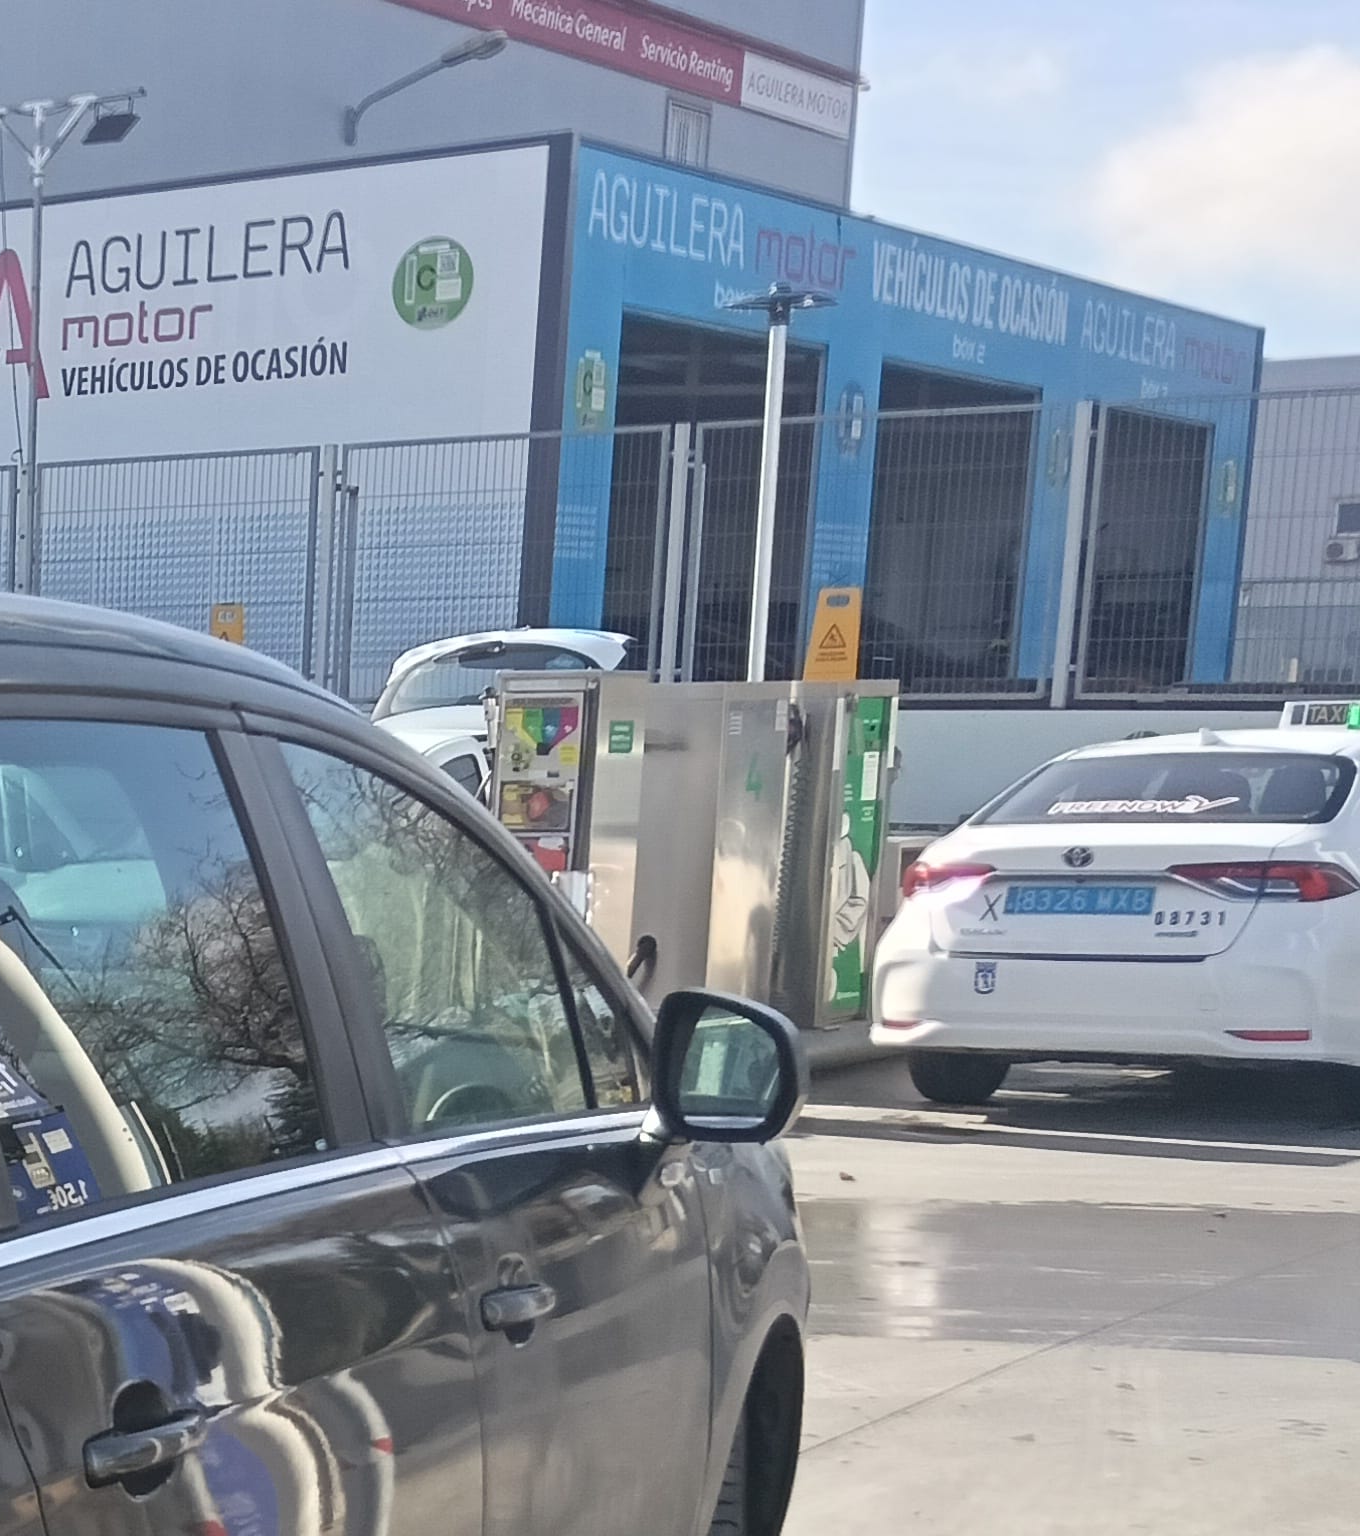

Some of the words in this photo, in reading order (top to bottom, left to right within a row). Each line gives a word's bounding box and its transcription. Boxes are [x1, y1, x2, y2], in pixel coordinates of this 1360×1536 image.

[510, 0, 574, 35] Mecánica
[574, 13, 627, 53] General
[640, 33, 688, 71] Servicio
[688, 51, 735, 93] Renting
[746, 72, 805, 110] AGUILERA
[805, 88, 849, 121] MOTOR
[64, 209, 351, 298] AGUILERA
[588, 168, 745, 271] AGUILERA
[754, 225, 858, 291] motor
[872, 238, 972, 325] VEHÍCULOS
[972, 267, 996, 331] DE
[998, 275, 1070, 348] OCASIÓN
[61, 300, 214, 351] motor
[952, 334, 976, 362] box
[1081, 298, 1177, 370] AGUILERA
[61, 356, 189, 397] VEHÍCULOS
[195, 354, 226, 387] DE
[231, 336, 349, 384] OCASIÓN
[1309, 705, 1348, 723] TAXI
[1023, 889, 1088, 912] 8326
